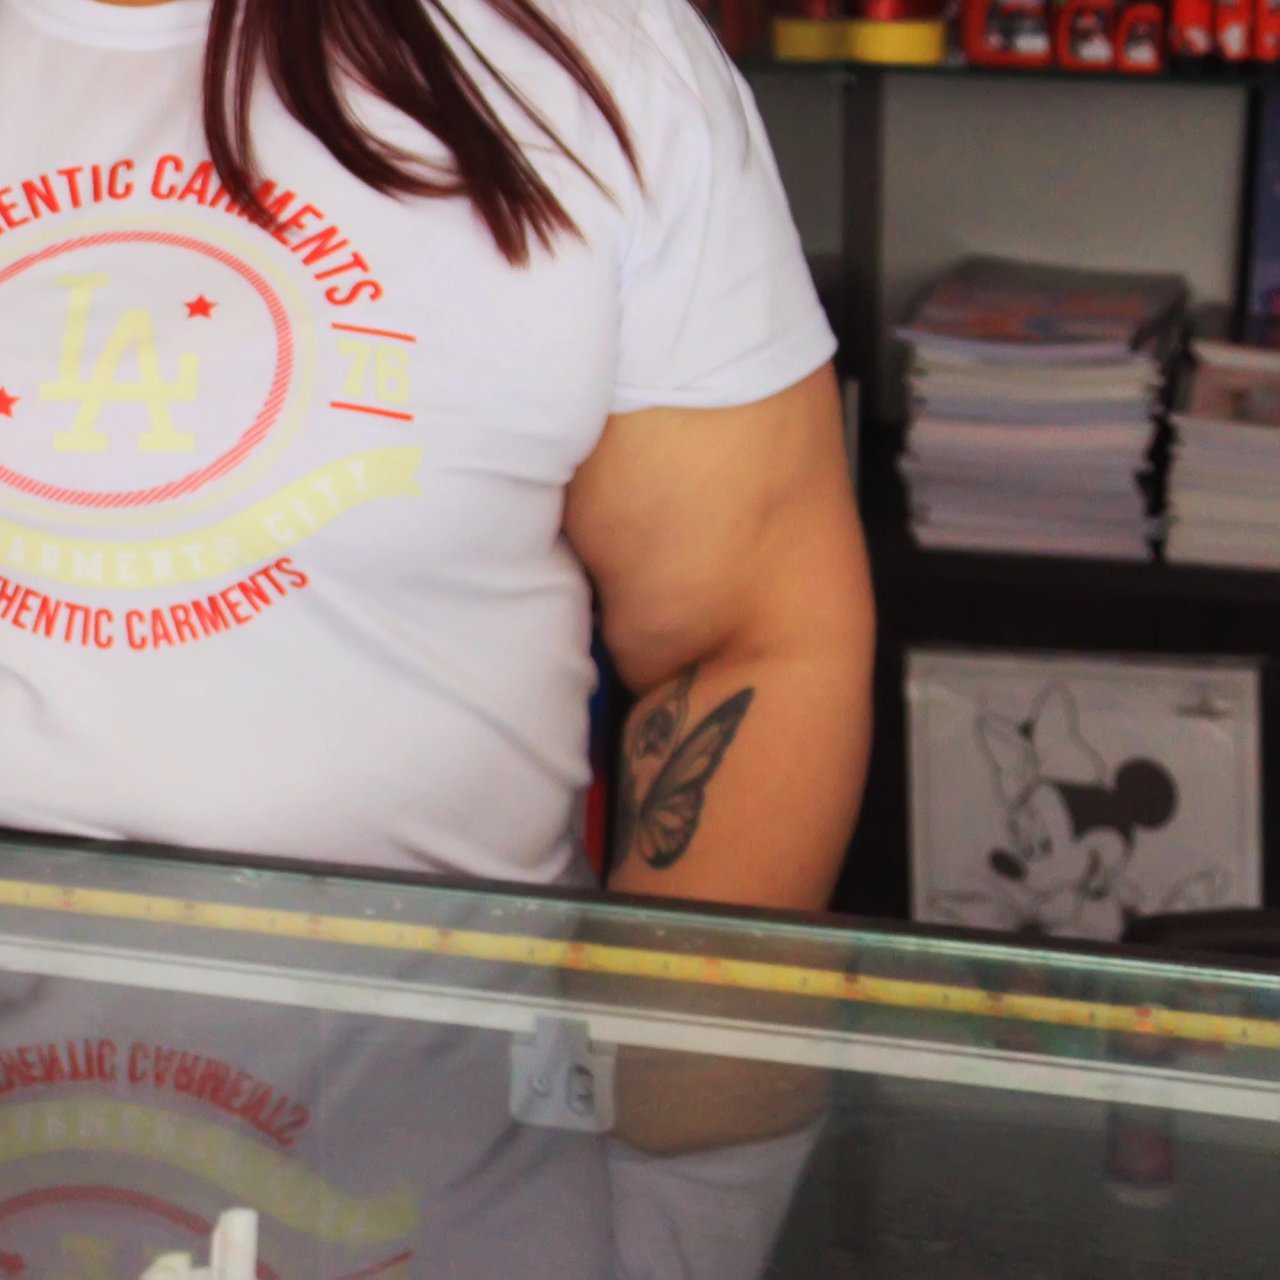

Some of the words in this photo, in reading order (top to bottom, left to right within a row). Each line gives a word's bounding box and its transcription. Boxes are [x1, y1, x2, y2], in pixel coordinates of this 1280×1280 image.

[40, 273, 200, 452] LA
[338, 339, 414, 405] 76
[125, 556, 310, 650] CARMENTS
